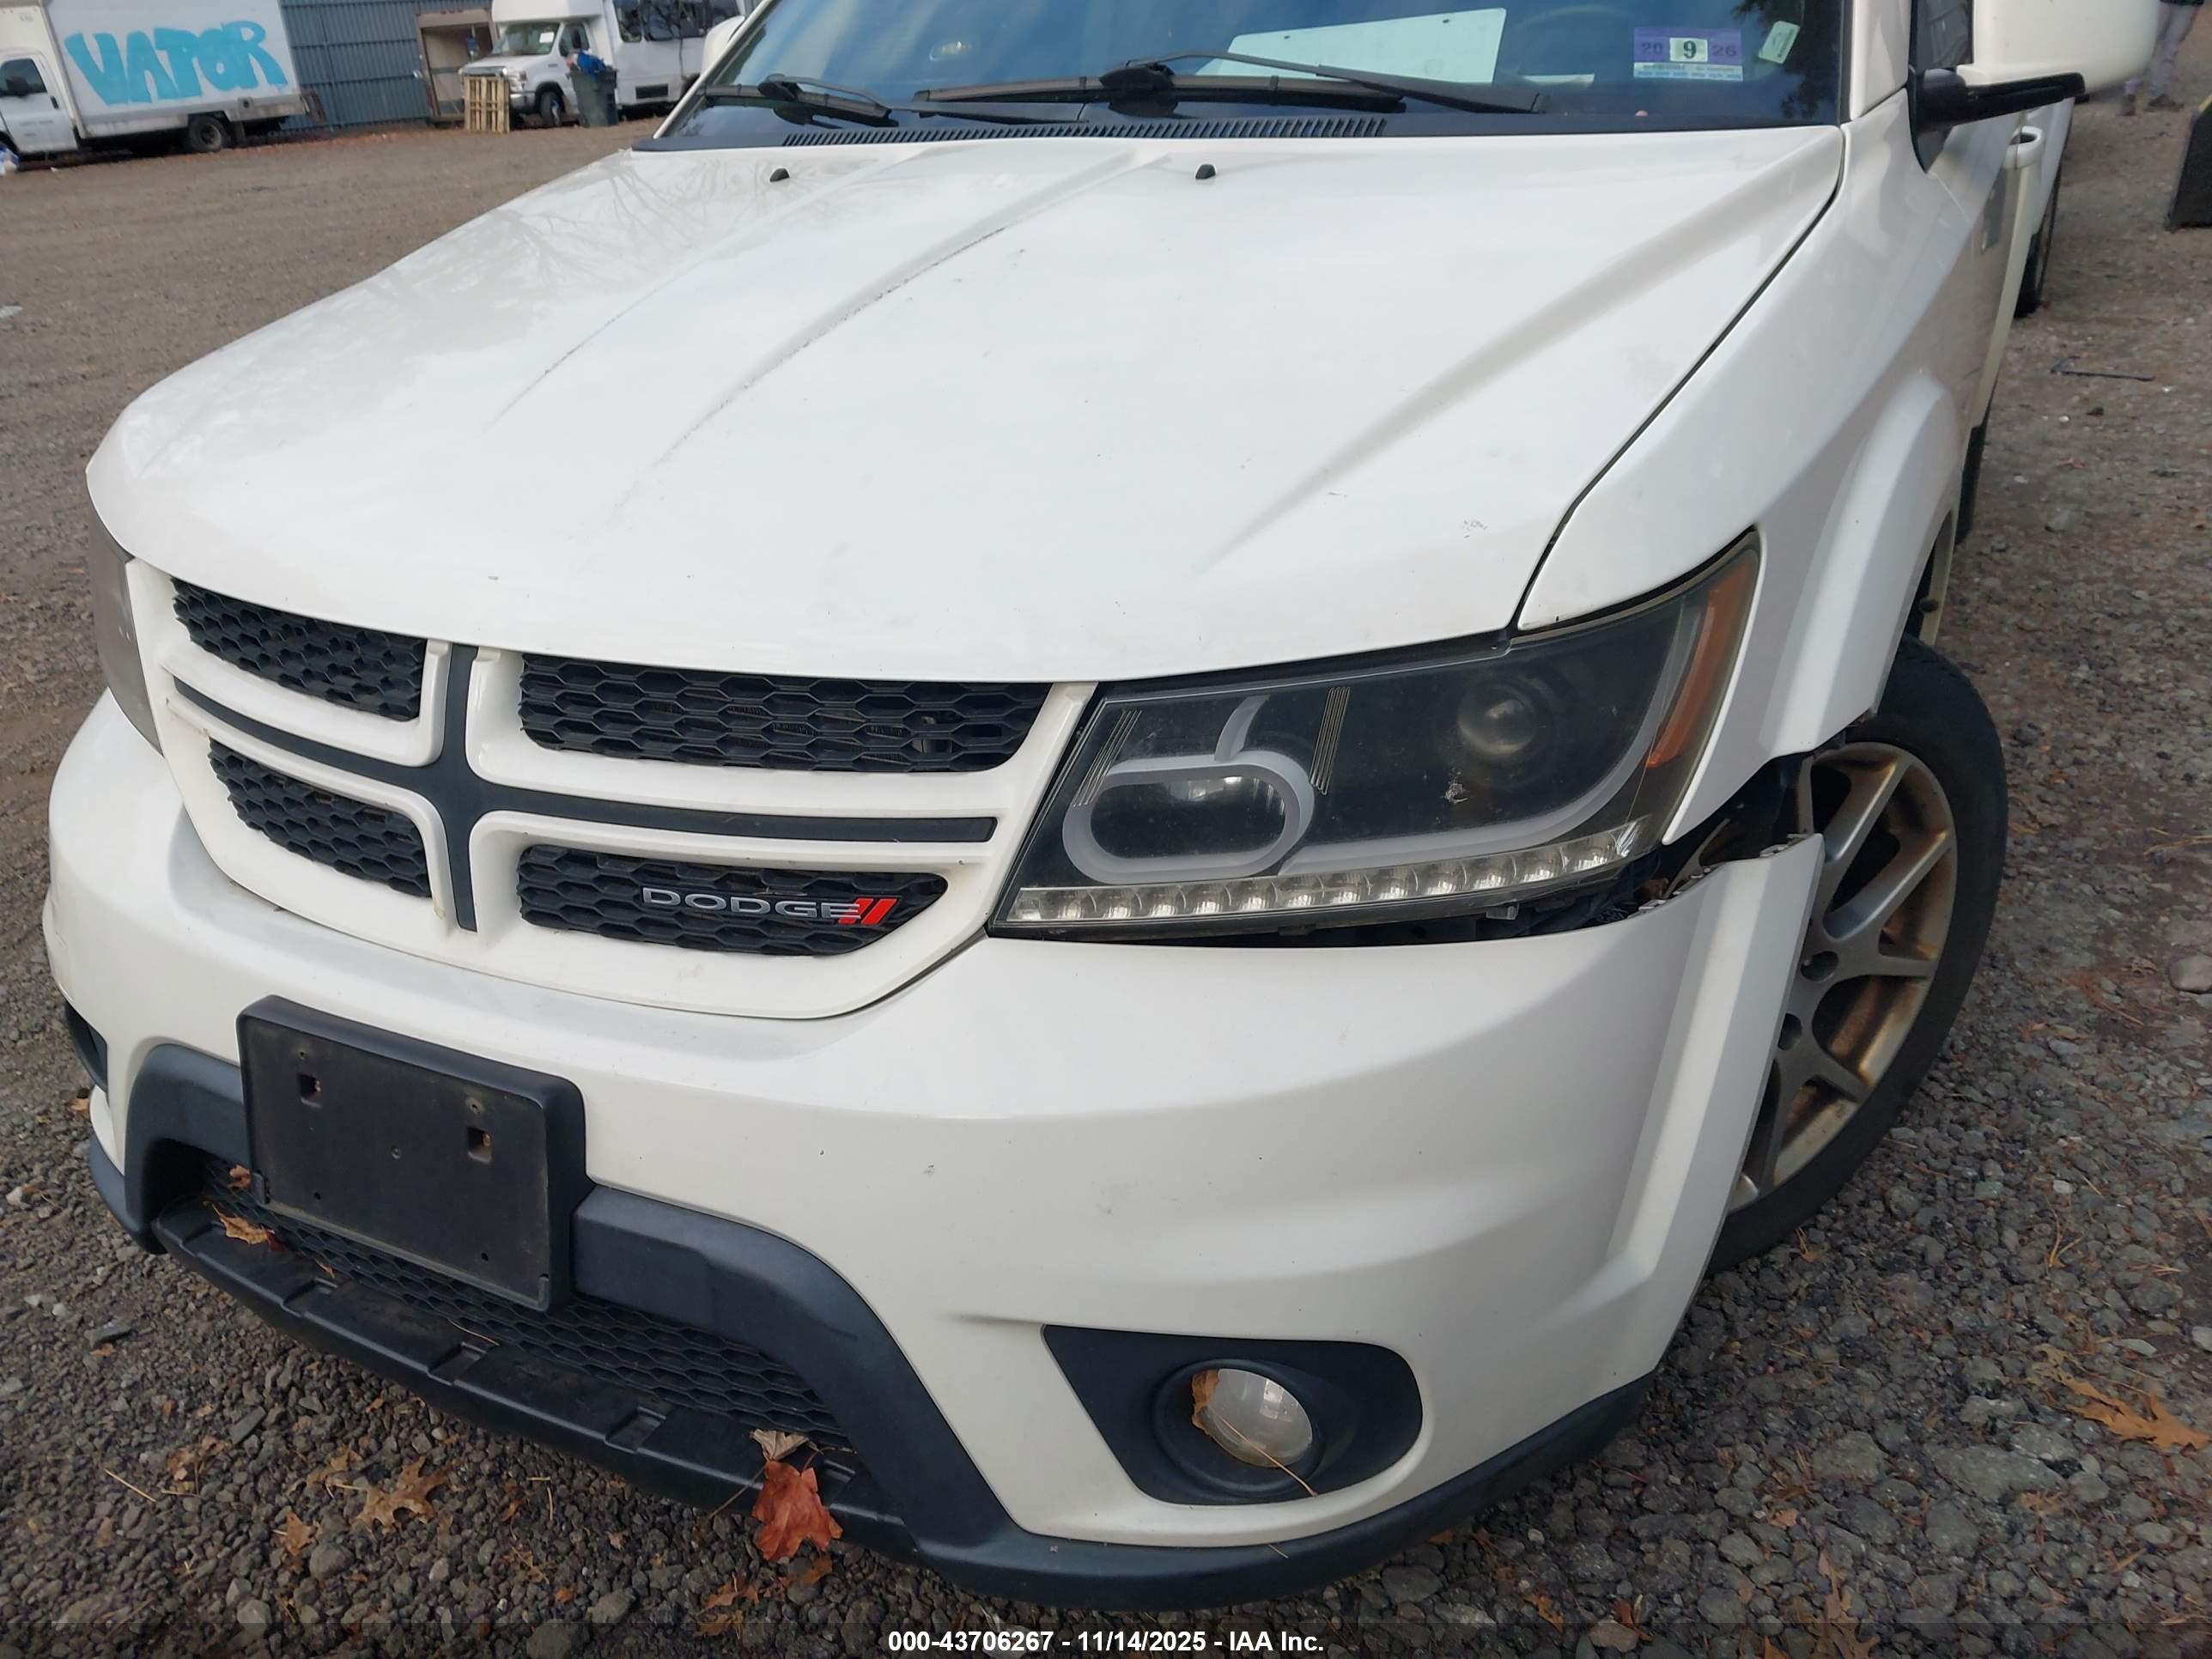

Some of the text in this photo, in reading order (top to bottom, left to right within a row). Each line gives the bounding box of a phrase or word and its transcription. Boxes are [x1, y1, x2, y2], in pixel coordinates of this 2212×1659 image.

[1641, 40, 1737, 59] 20 9 26
[641, 887, 861, 921] DODGE
